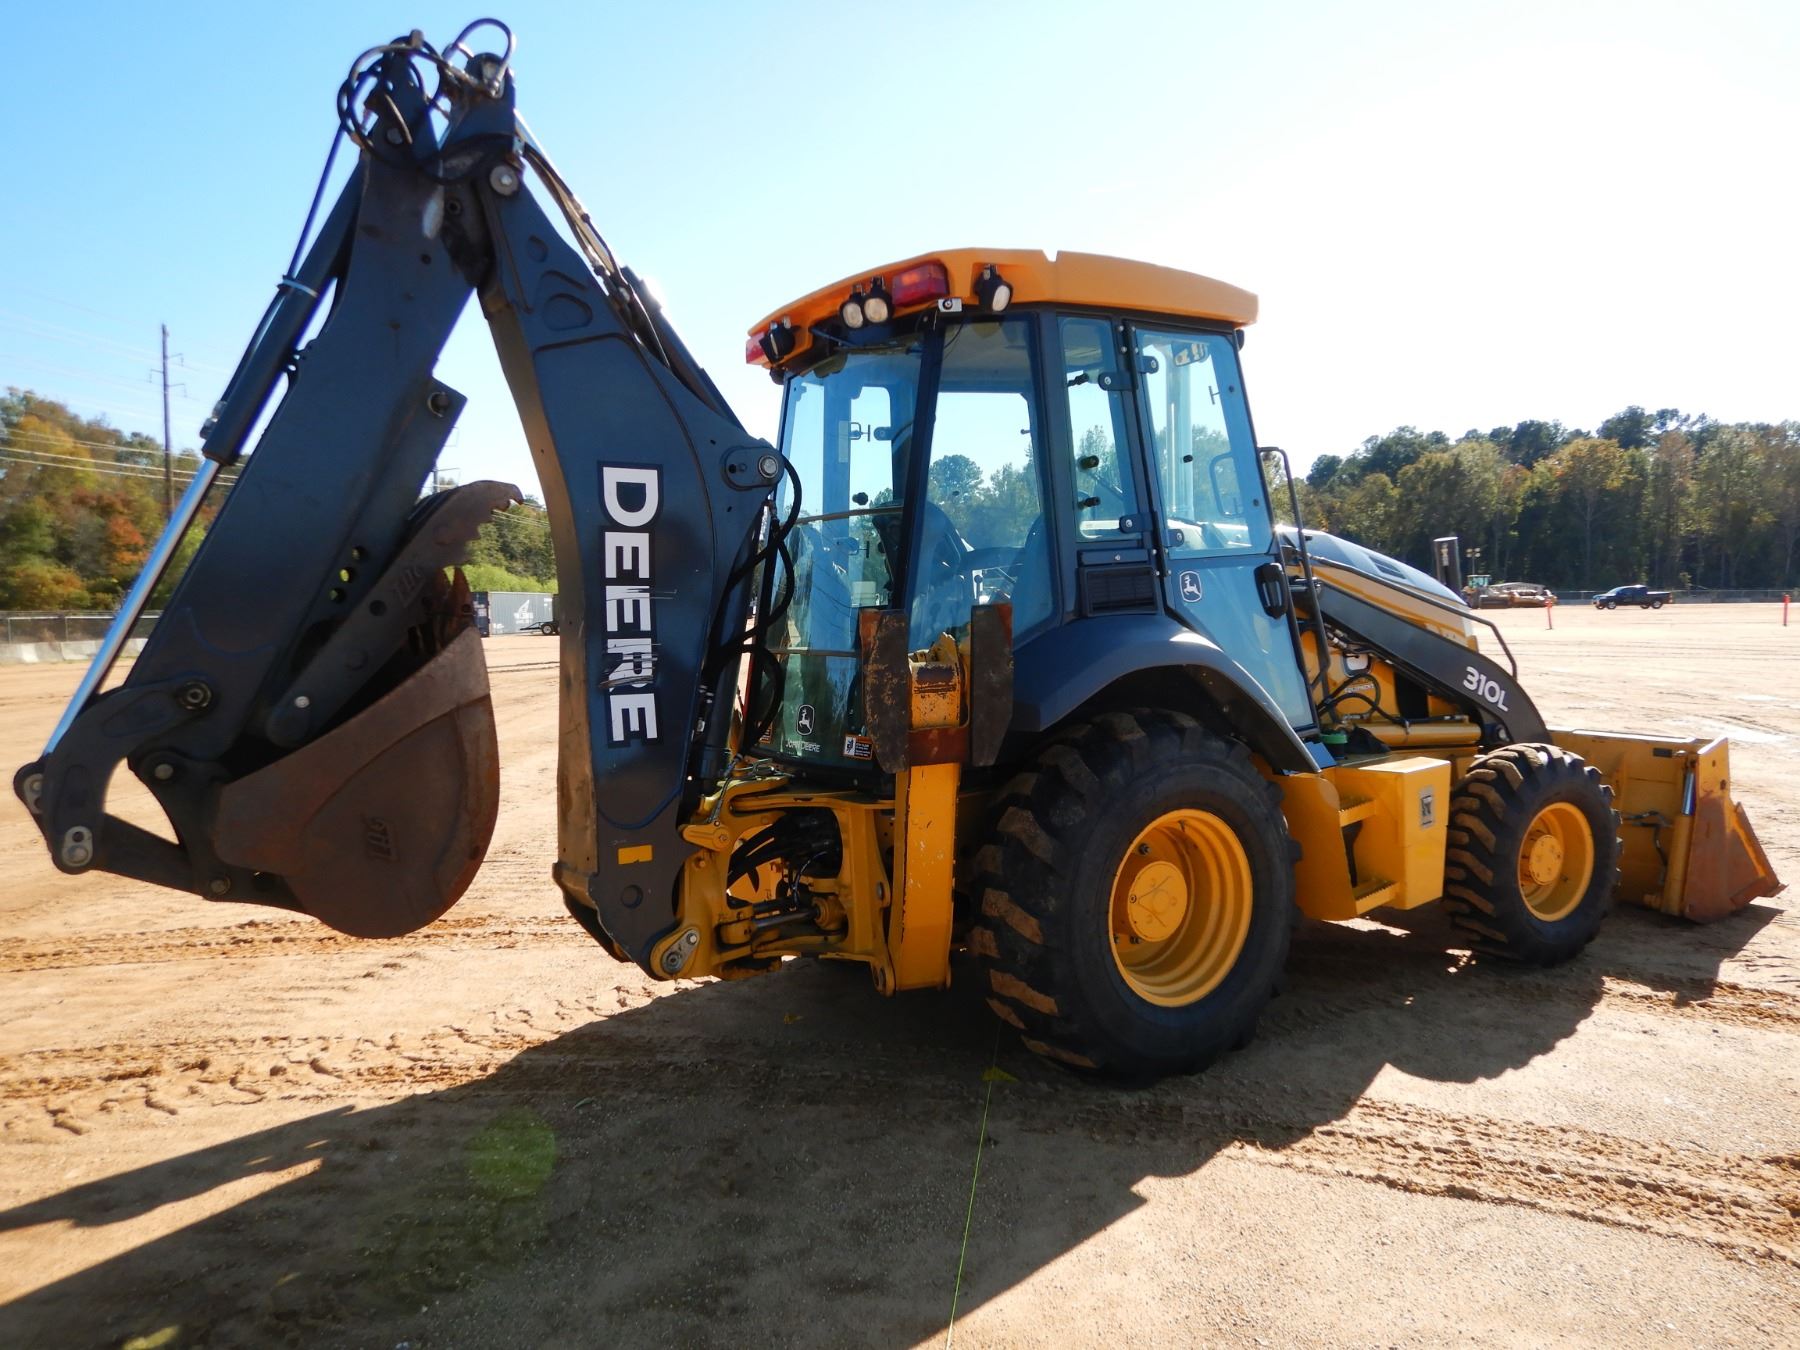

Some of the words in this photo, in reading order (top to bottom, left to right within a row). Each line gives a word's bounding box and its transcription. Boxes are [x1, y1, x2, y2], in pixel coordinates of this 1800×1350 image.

[602, 466, 659, 742] DEERE
[1462, 665, 1509, 712] 310L
[801, 741, 820, 753] DEERE
